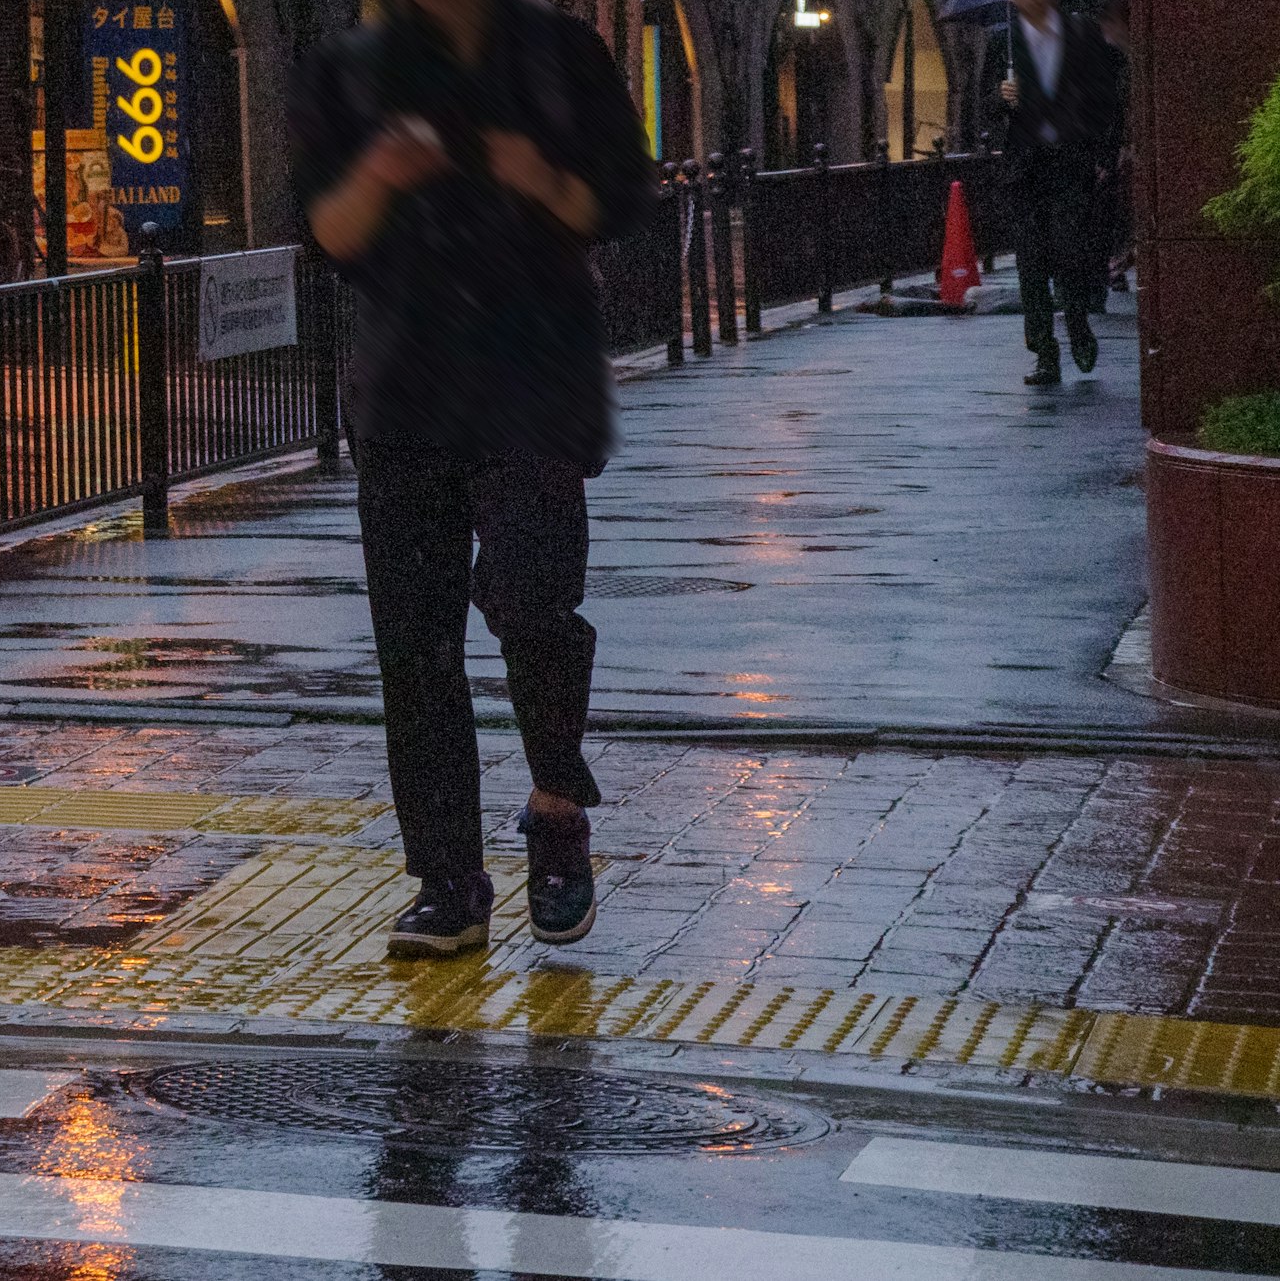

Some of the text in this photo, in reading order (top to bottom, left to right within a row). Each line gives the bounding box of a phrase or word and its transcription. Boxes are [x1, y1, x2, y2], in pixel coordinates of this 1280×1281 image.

[92, 5, 176, 30] タイ屋台
[115, 48, 164, 164] 999
